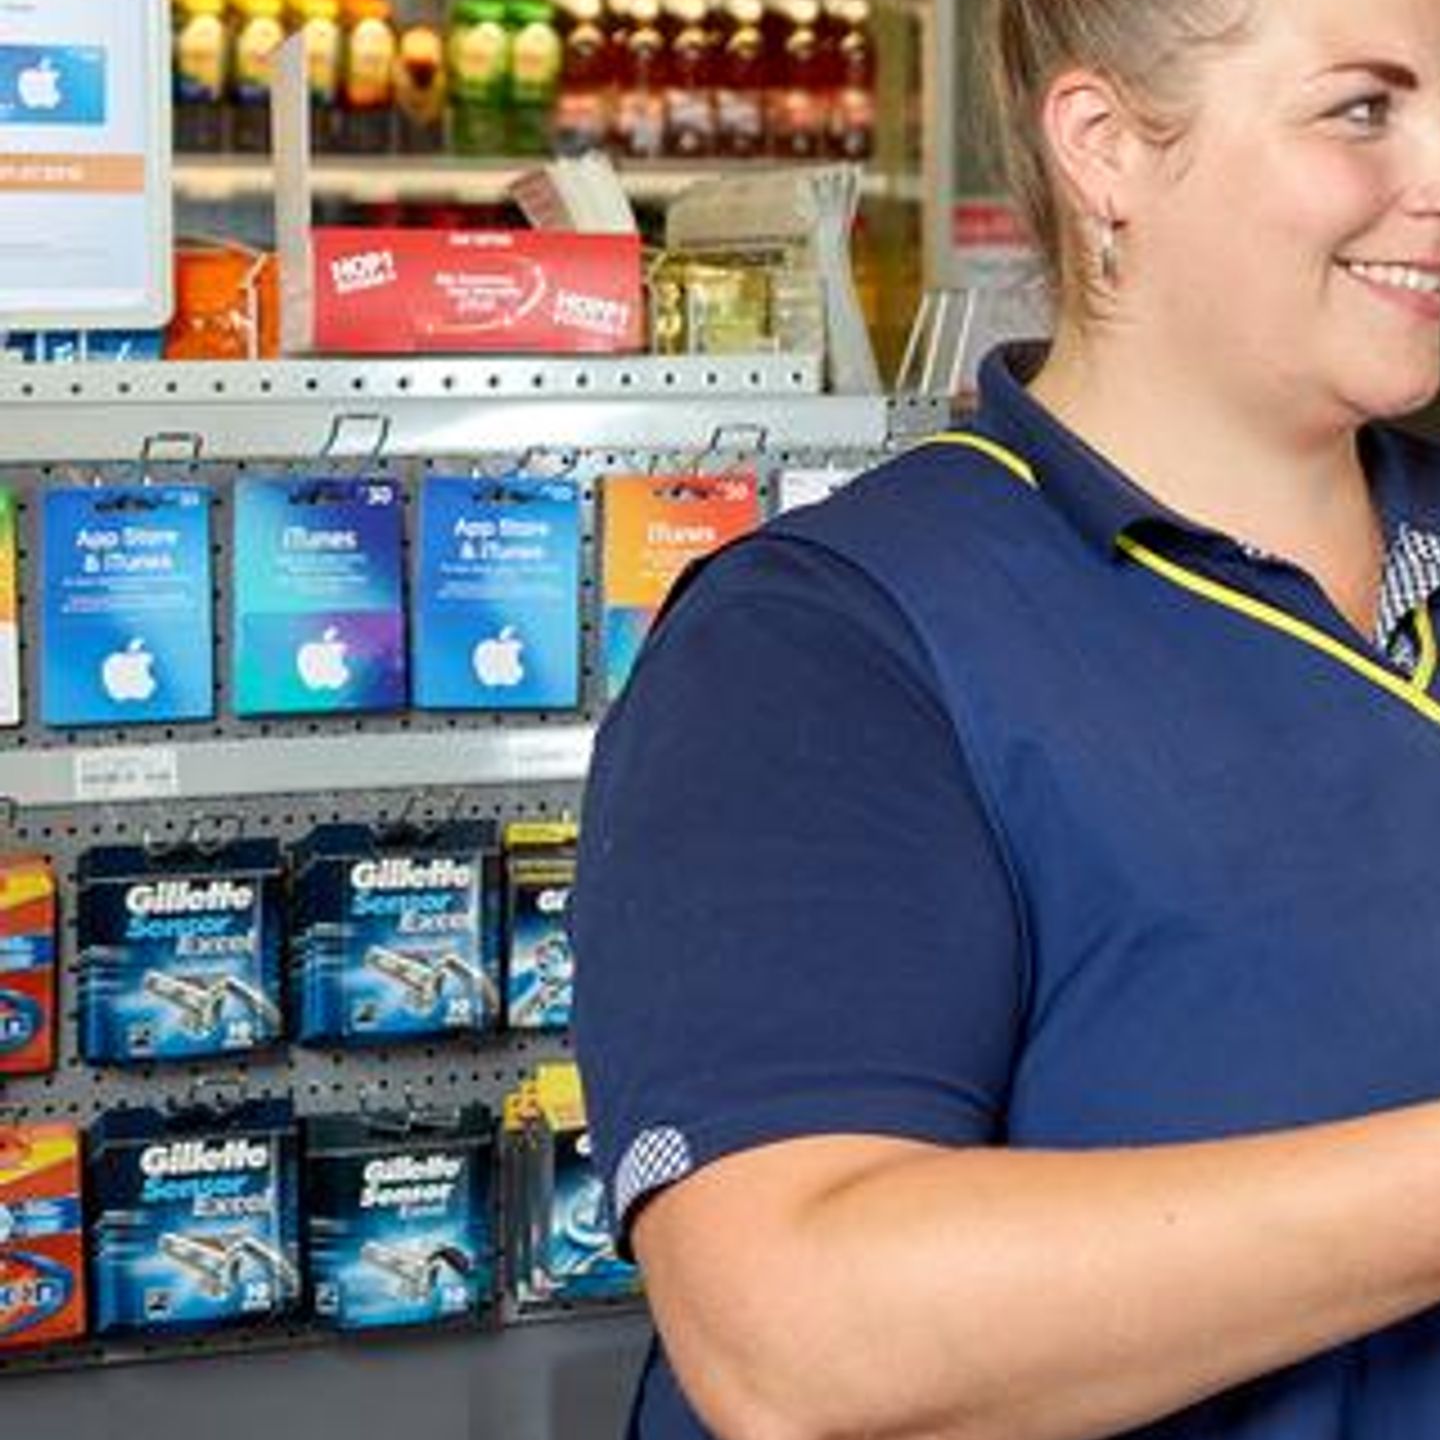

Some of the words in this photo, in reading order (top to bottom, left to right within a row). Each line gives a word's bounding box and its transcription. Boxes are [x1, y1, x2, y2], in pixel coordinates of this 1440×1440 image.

[284, 526, 358, 551] iTunes
[350, 857, 474, 891] Gillette
[126, 880, 255, 915] Gillette
[351, 891, 454, 916] Sensor
[126, 914, 233, 940] Sensor
[139, 1138, 268, 1176] Gillette
[363, 1155, 461, 1184] Gillette
[141, 1176, 249, 1203] Sensor
